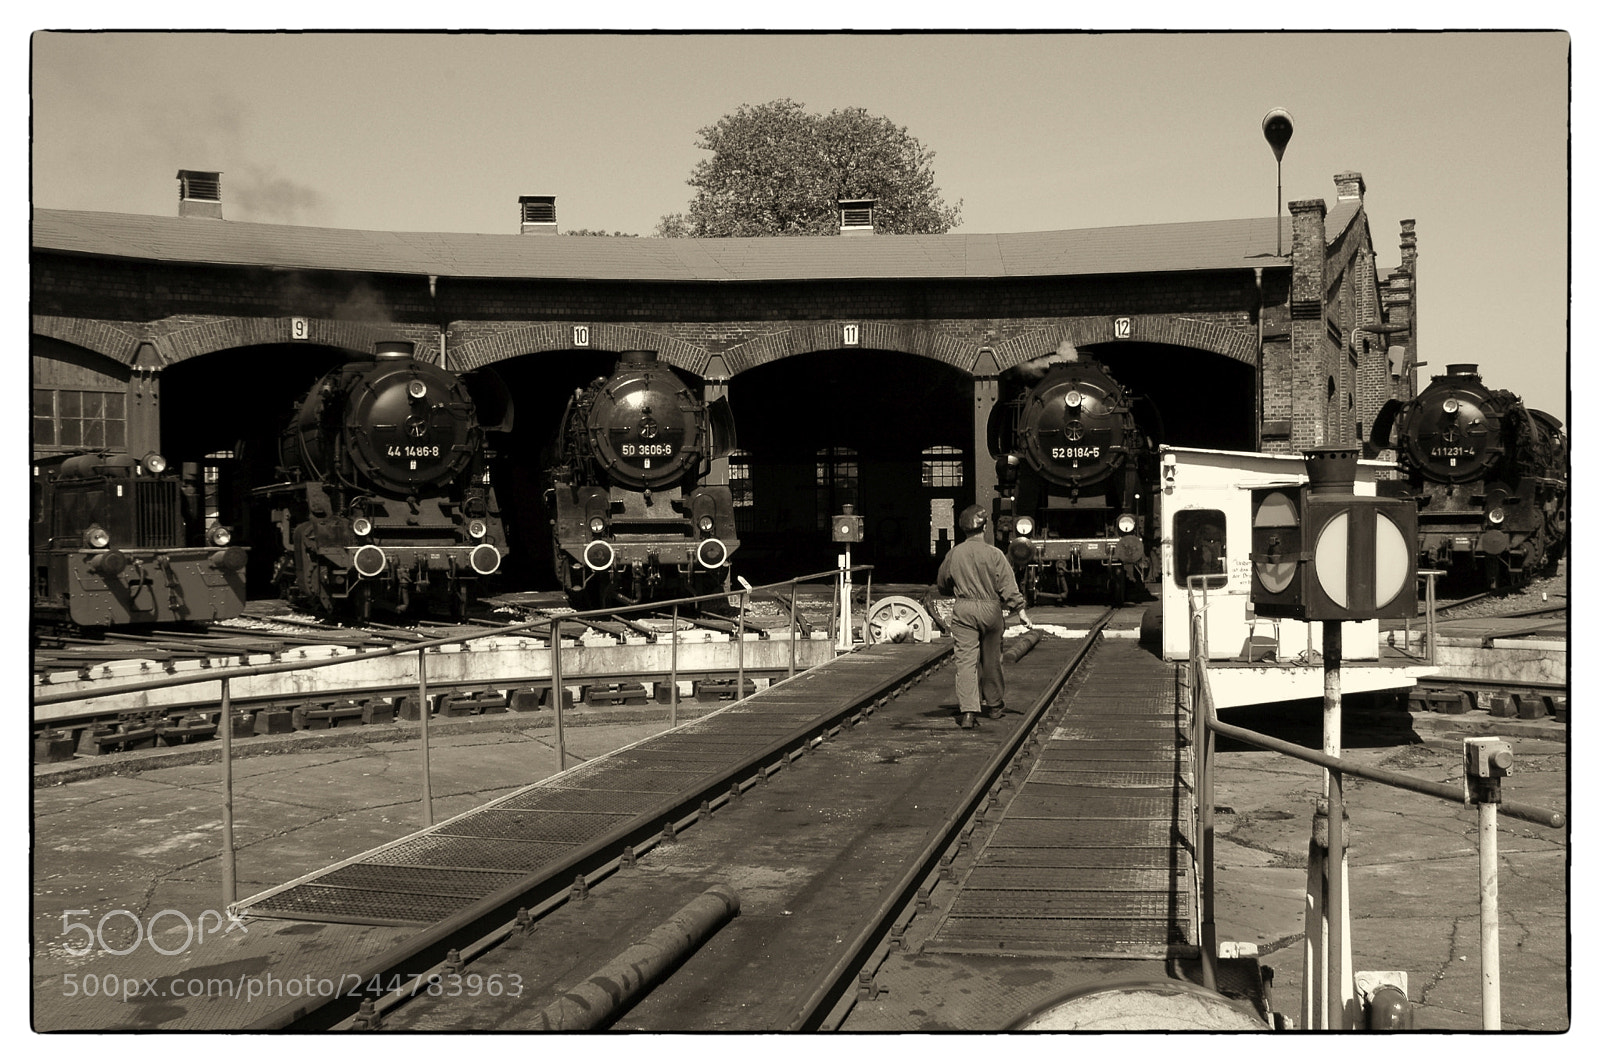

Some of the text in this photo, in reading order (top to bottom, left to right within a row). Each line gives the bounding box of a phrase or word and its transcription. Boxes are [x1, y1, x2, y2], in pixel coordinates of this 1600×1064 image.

[295, 320, 304, 337] 9
[845, 327, 855, 343] 11
[1116, 319, 1129, 336] 12
[575, 328, 587, 344] 10
[387, 446, 439, 457] 44 1486-8
[622, 444, 672, 456] 50 3606-6
